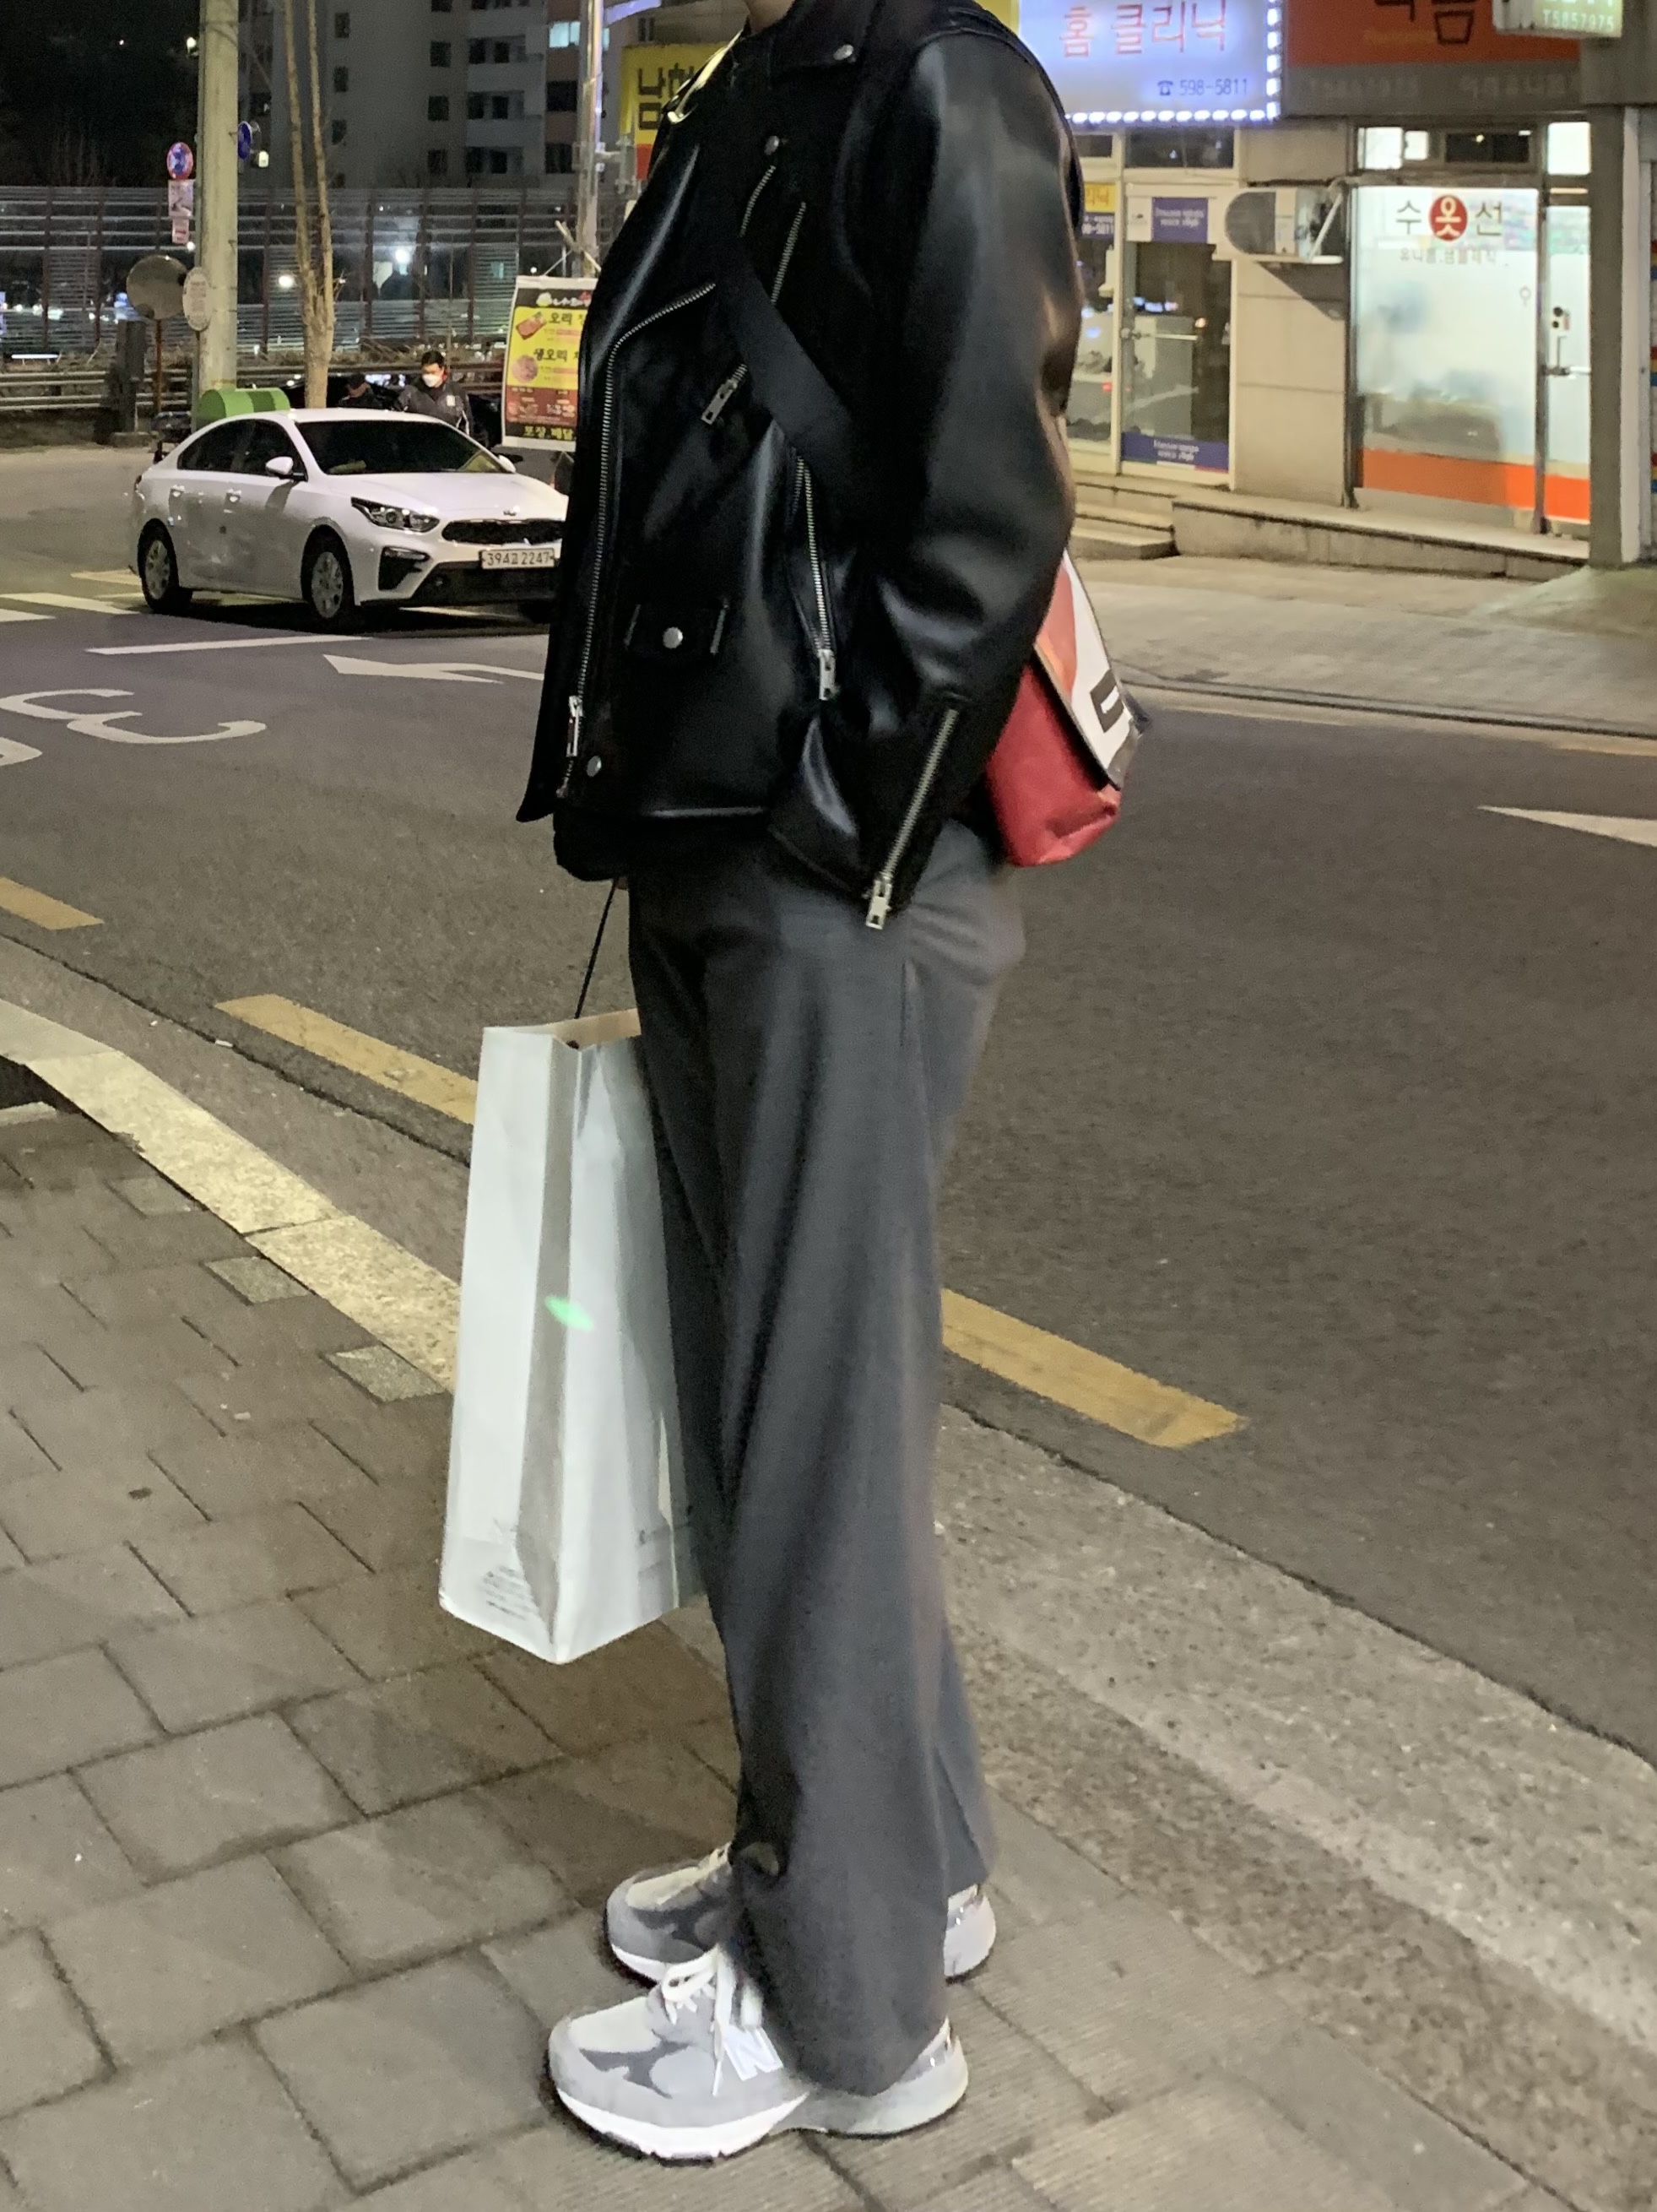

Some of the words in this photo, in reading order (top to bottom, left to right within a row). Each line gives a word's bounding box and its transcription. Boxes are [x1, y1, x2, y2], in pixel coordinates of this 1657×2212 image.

[1059, 6, 1095, 58] 홈
[1111, 0, 1227, 55] 클리닉
[1179, 78, 1248, 96] 598-5811
